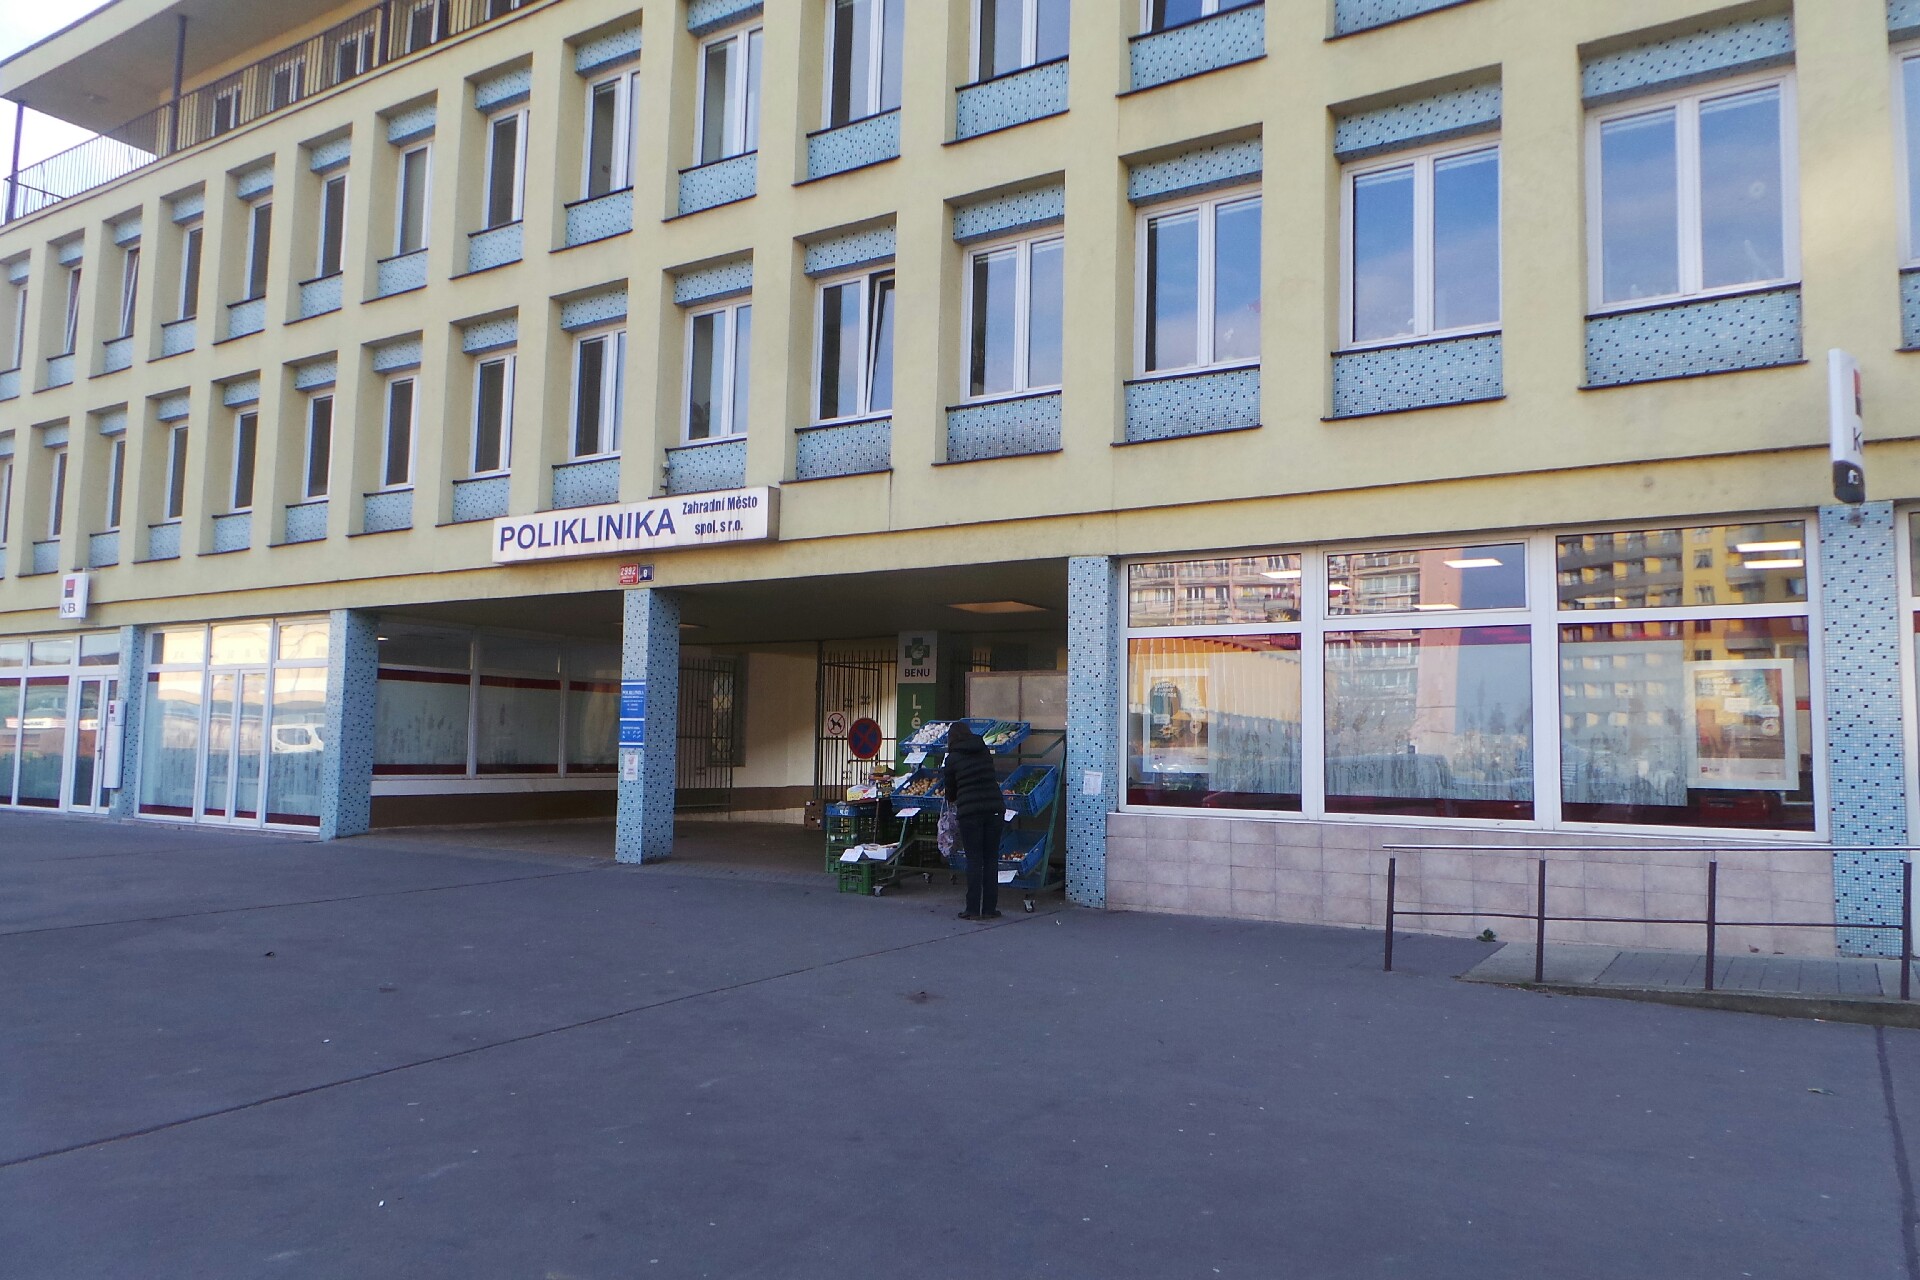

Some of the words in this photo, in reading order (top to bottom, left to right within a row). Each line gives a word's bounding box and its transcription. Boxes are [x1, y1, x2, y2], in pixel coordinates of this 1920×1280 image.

[682, 497, 725, 515] Zahradní
[727, 495, 758, 511] Město
[500, 508, 676, 551] POLIKLINIKA
[694, 519, 718, 535] spol.
[720, 521, 726, 533] s
[728, 520, 743, 532] r.o.
[620, 566, 636, 576] 2992
[61, 602, 76, 614] KB
[904, 668, 930, 677] BENU
